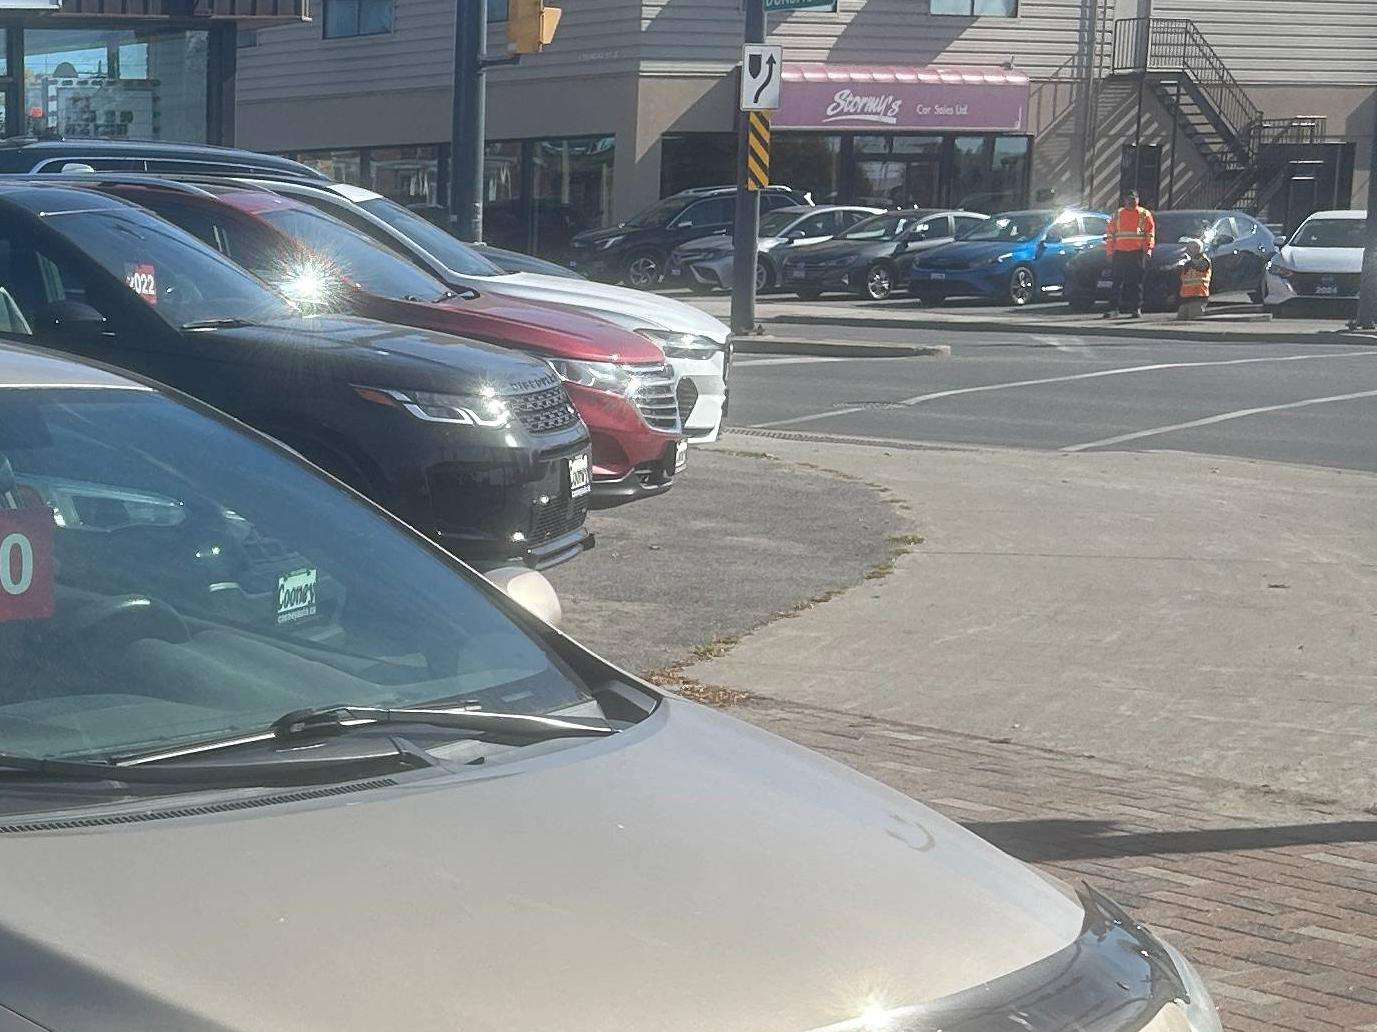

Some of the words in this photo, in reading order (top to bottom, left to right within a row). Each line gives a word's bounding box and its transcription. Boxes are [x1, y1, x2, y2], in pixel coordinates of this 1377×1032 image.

[826, 88, 902, 117] Stormy's
[916, 104, 931, 115] Car
[934, 104, 954, 115] Sales
